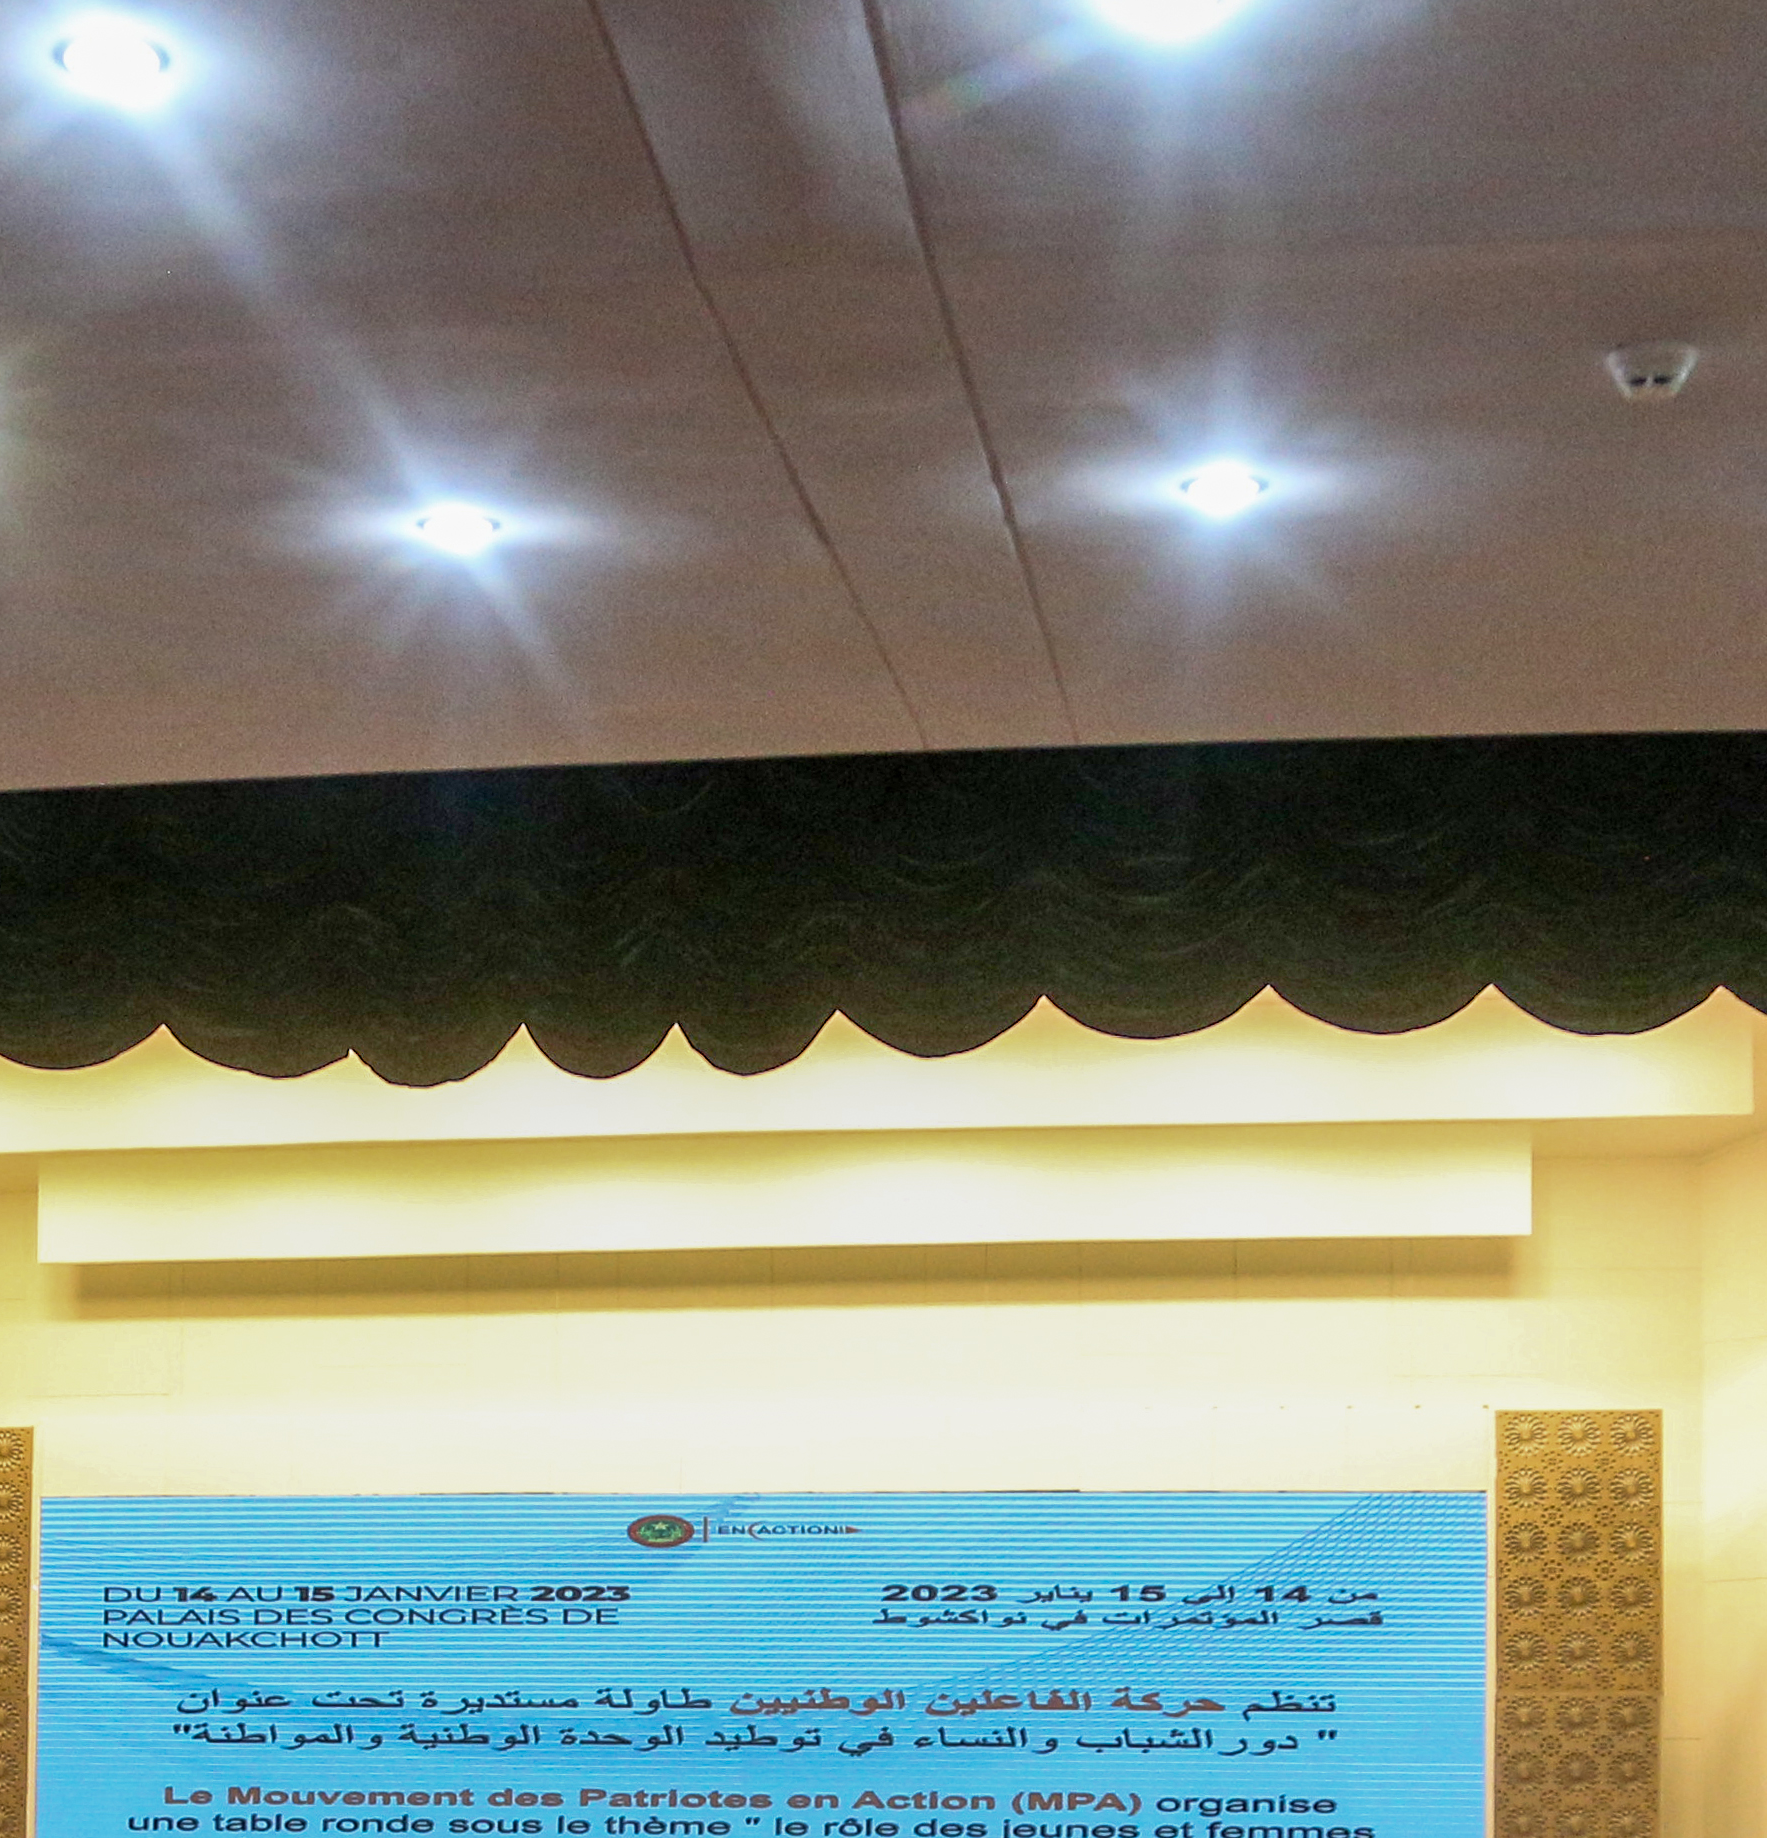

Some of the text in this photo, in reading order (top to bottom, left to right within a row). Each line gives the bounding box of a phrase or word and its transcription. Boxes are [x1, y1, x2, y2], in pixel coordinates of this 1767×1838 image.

[104, 1585, 631, 1602] DU 14 AU 15 JANVIER 2023
[881, 1584, 998, 1601] 2023
[1016, 1584, 1093, 1604] يناير
[1110, 1584, 1166, 1602] 15
[1255, 1585, 1311, 1602] 14
[1328, 1589, 1378, 1604] من
[103, 1605, 620, 1625] PALAIS DES CONGRÈS DE
[872, 1608, 1027, 1628] نواكشوط
[1041, 1609, 1088, 1631] في
[1298, 1610, 1384, 1629] قصر
[103, 1631, 390, 1648] NOUAKCHOTT
[177, 1686, 1336, 1722] تنظم حركة الفاعلين الوطنيين طاولة مستديرة تحت عنوان
[397, 1723, 541, 1752] الوطنية
[559, 1724, 684, 1752] الوحدة
[705, 1723, 822, 1752] توطيد
[838, 1726, 894, 1757] في
[164, 1786, 1338, 1818] Le Mouvement des Patriotes en Action (MPA) organise
[127, 1816, 200, 1832] une
[212, 1813, 308, 1832] table
[322, 1814, 434, 1833] ronde
[448, 1818, 543, 1835] sous
[557, 1815, 591, 1835] le
[604, 1815, 732, 1836] thème
[775, 1817, 809, 1837] le
[824, 1817, 900, 1838] rôle
[913, 1818, 988, 1838] des
